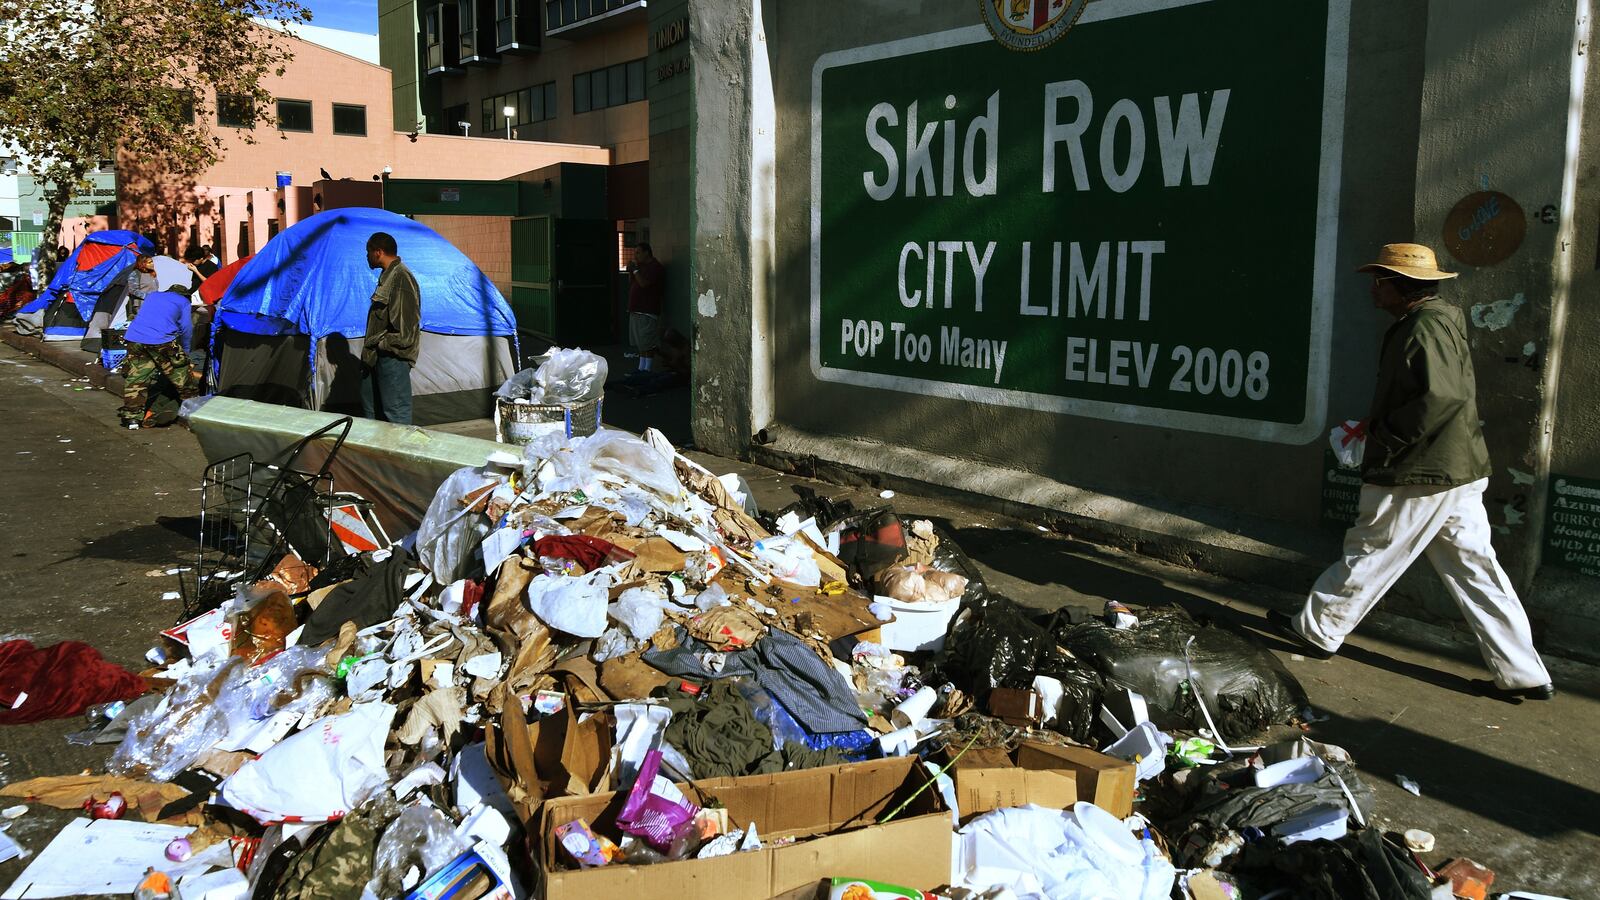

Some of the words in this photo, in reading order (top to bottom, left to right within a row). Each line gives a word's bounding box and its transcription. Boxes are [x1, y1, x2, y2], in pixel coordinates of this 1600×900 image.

[654, 19, 684, 48] UNION
[1000, 29, 1045, 47] FOUNDED
[863, 88, 1000, 200] Skid
[898, 240, 998, 313] CITY
[1019, 239, 1166, 322] LIMIT
[840, 318, 884, 358] POP
[939, 325, 1008, 384] Many
[1065, 336, 1160, 388] ELEV
[1168, 344, 1271, 401] 2008
[1552, 511, 1591, 527] CHRIS
